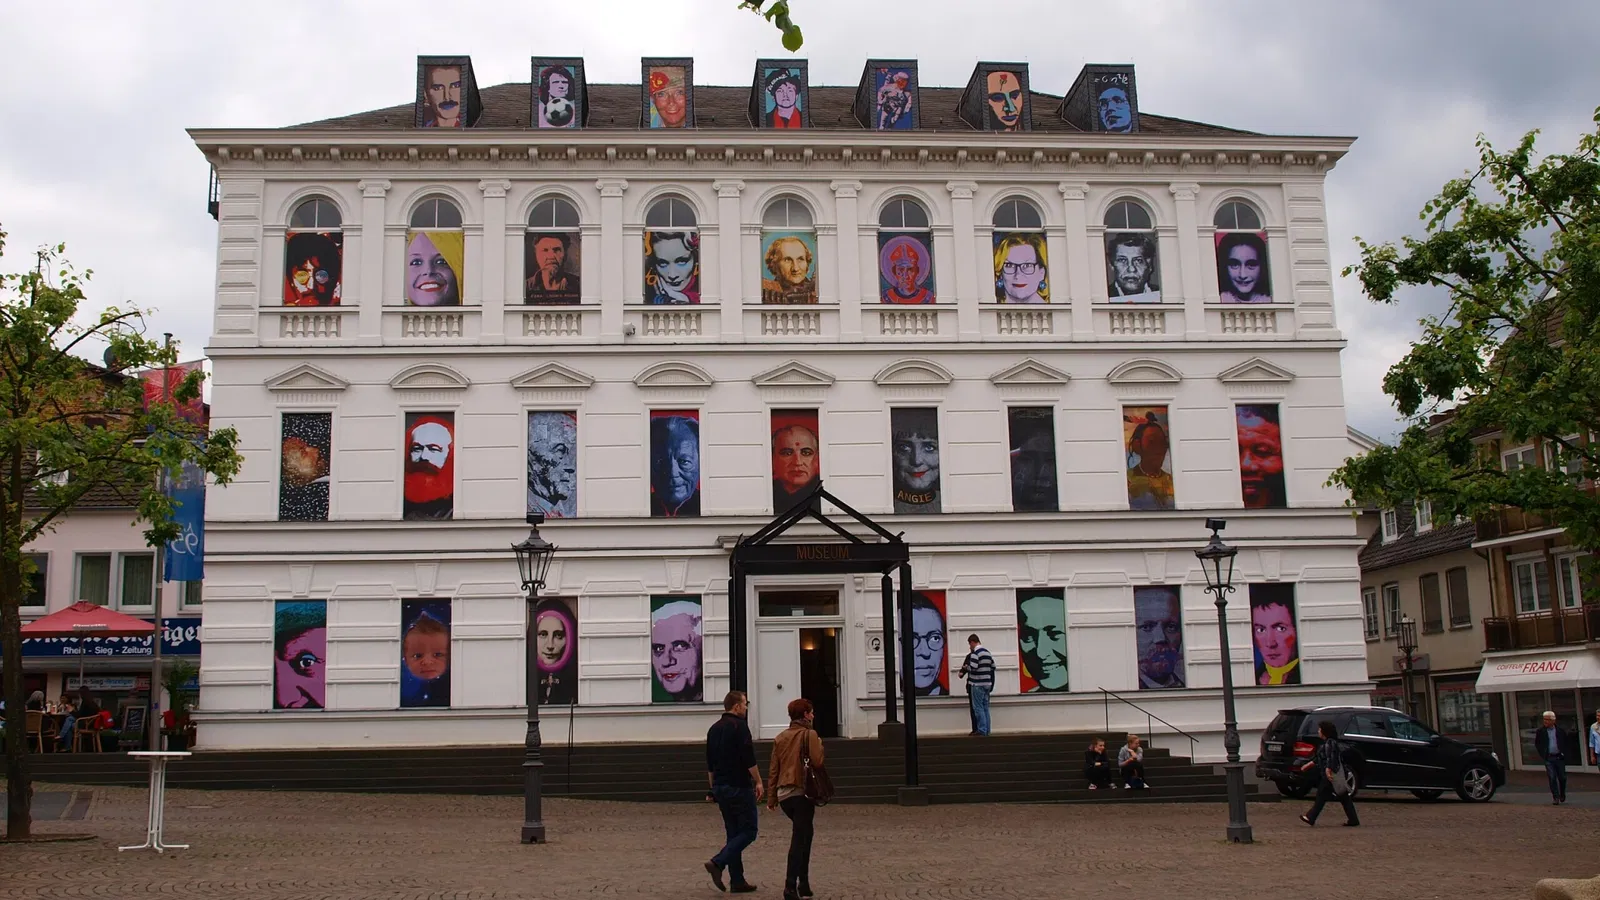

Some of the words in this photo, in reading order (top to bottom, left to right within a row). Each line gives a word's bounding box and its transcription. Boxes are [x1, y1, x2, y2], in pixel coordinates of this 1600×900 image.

[897, 489, 933, 503] ANGIE
[796, 545, 850, 560] MUSEUM
[94, 646, 113, 656] Sieg
[121, 646, 152, 656] Zeitung
[1496, 663, 1524, 671] COIFFEUR
[1522, 659, 1569, 673] FRANCI
